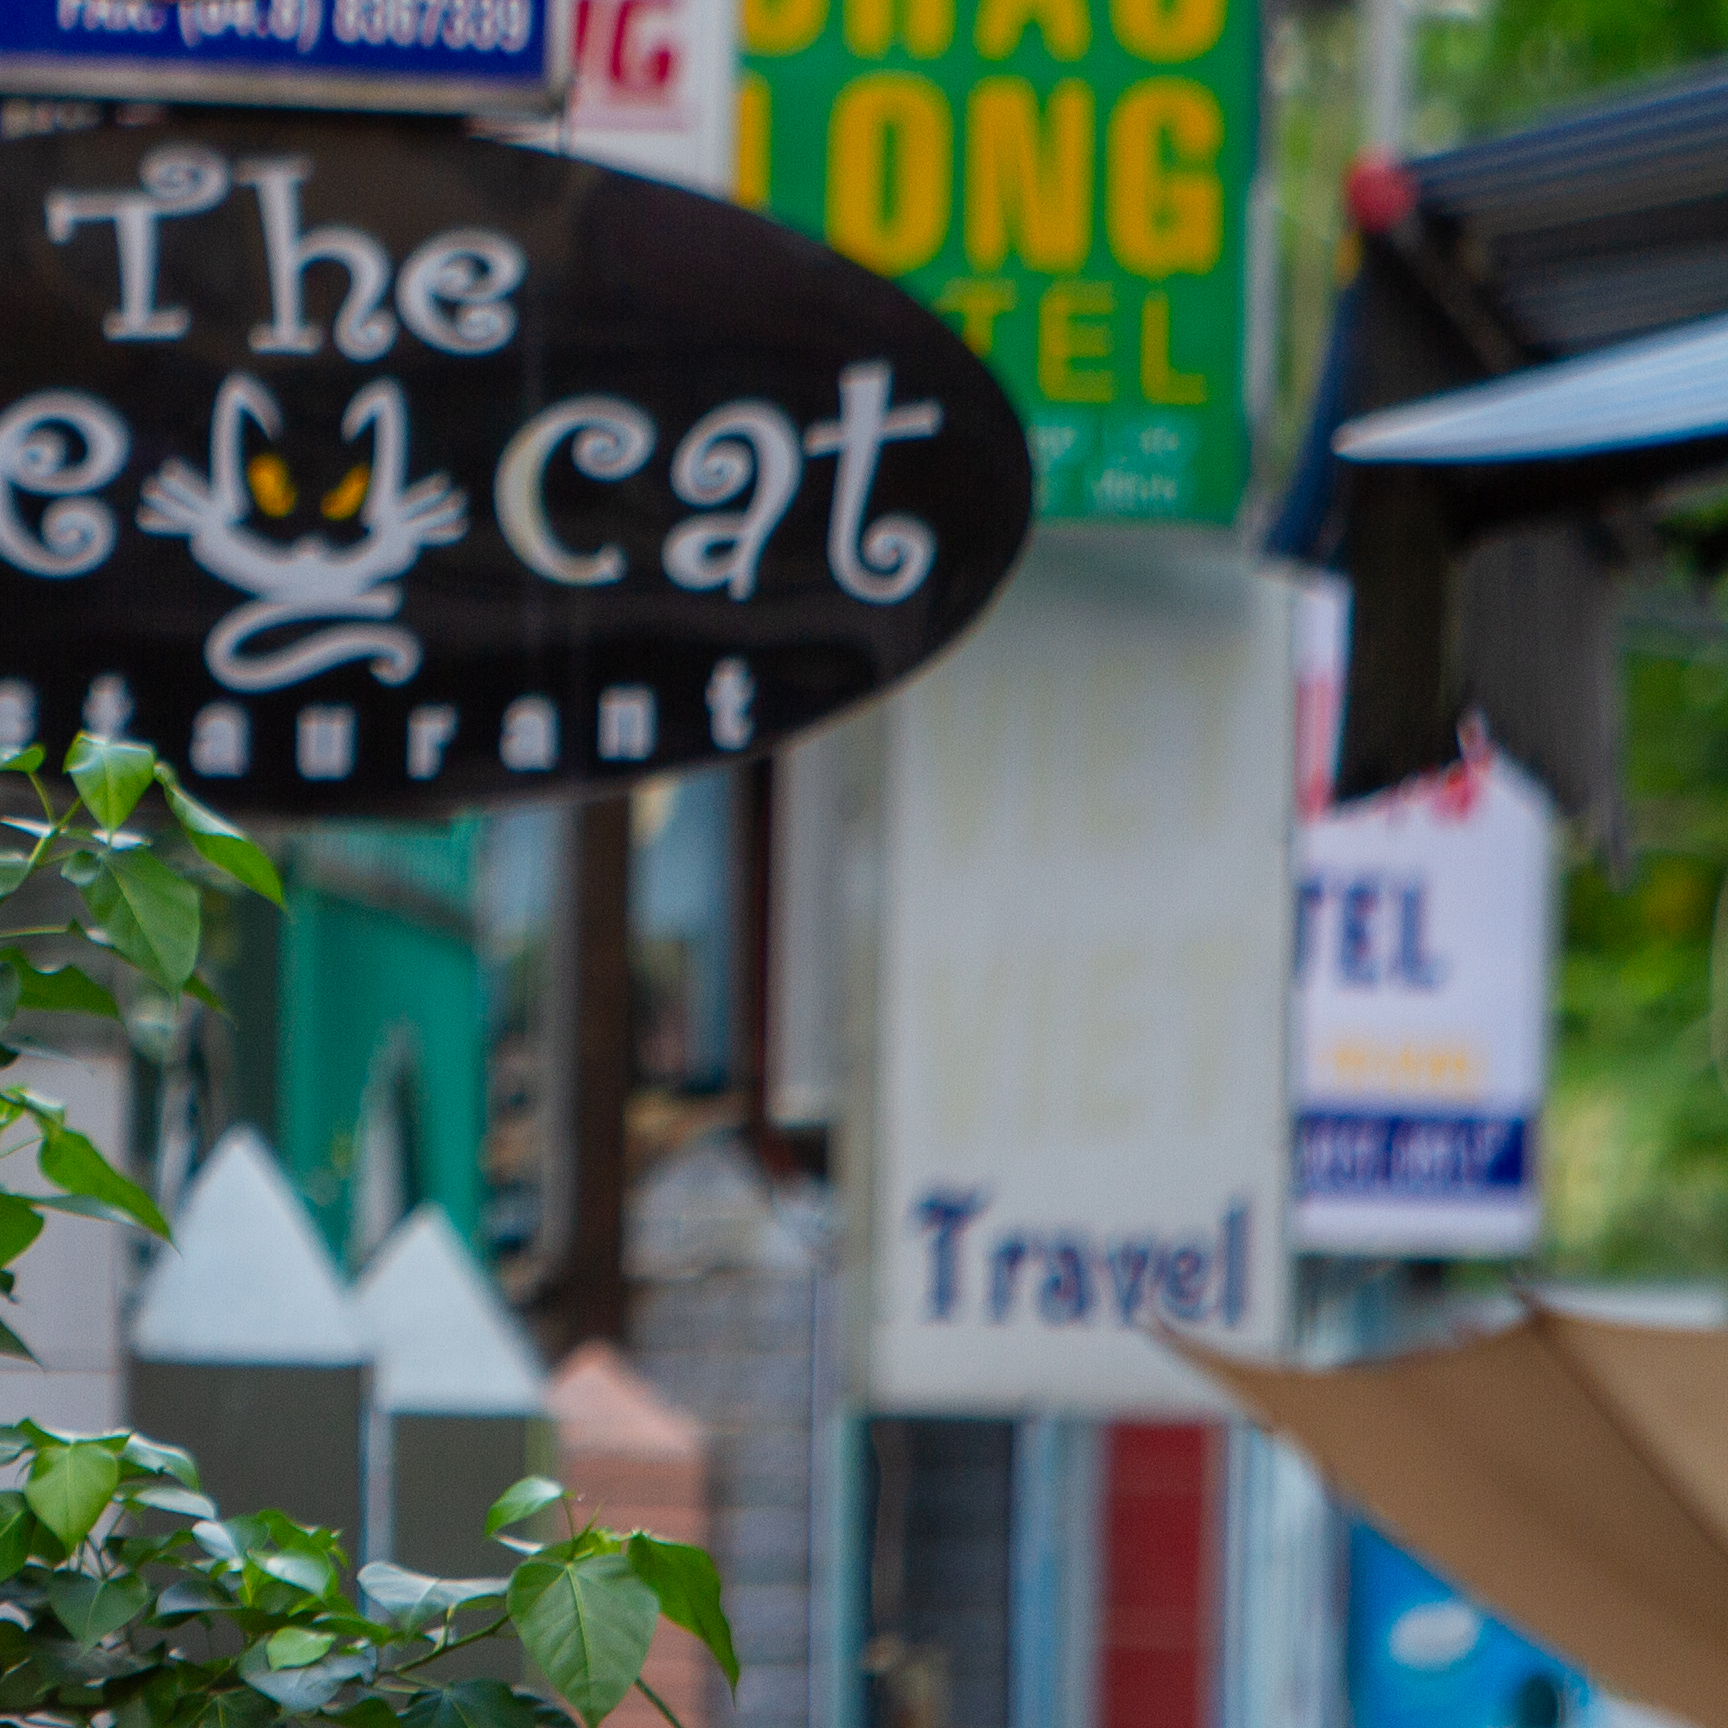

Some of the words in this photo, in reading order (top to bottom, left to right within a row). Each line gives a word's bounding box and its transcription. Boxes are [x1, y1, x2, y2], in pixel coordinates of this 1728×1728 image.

[46, 143, 525, 360] The
[494, 358, 942, 603] cat
[906, 1178, 1255, 1332] Travel
